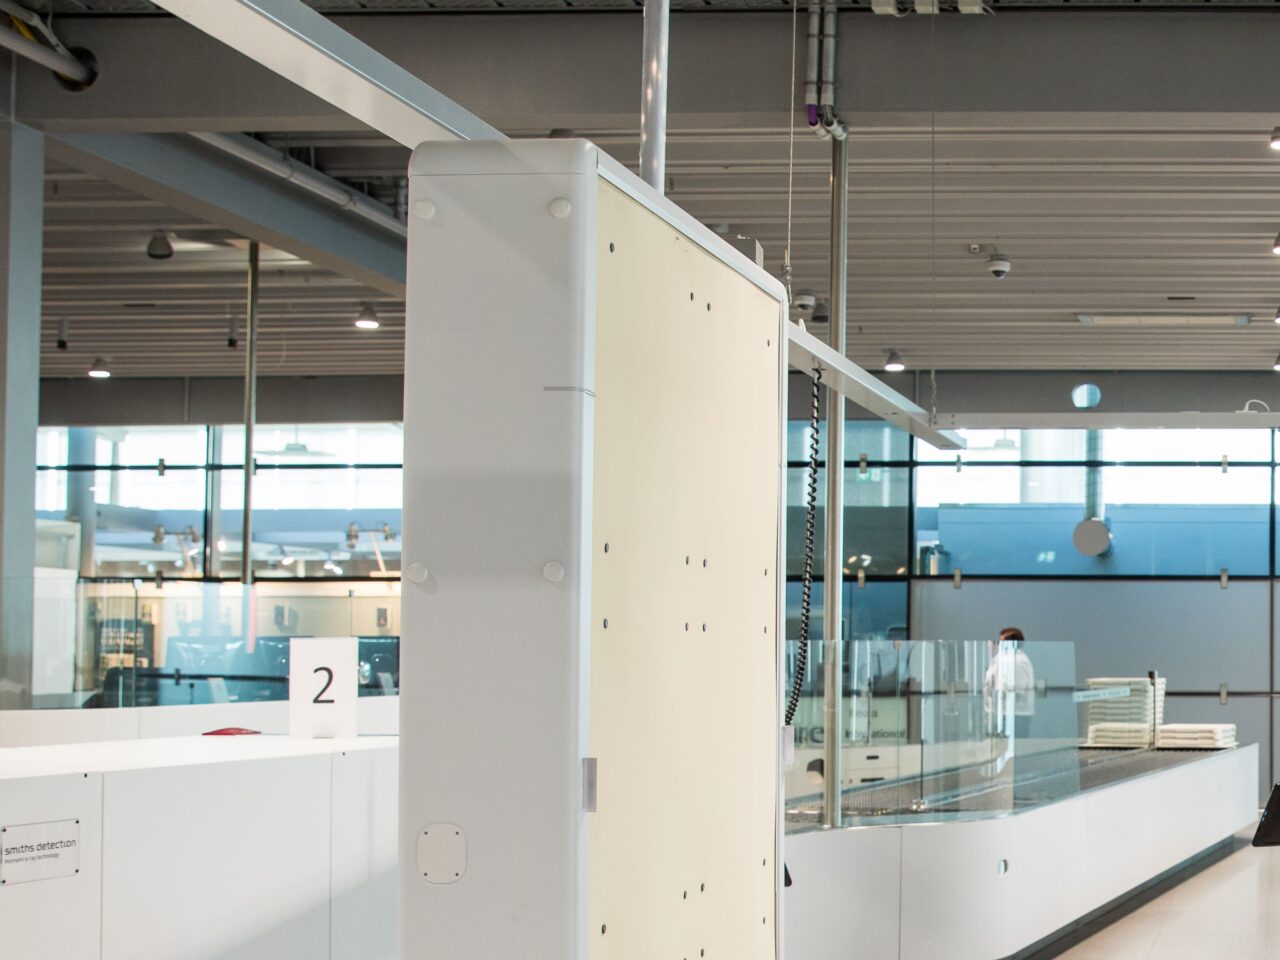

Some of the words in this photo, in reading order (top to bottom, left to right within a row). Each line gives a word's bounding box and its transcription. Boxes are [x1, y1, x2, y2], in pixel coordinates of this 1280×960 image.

[312, 666, 335, 704] 2
[4, 844, 35, 856] smiths
[36, 839, 77, 851] detection
